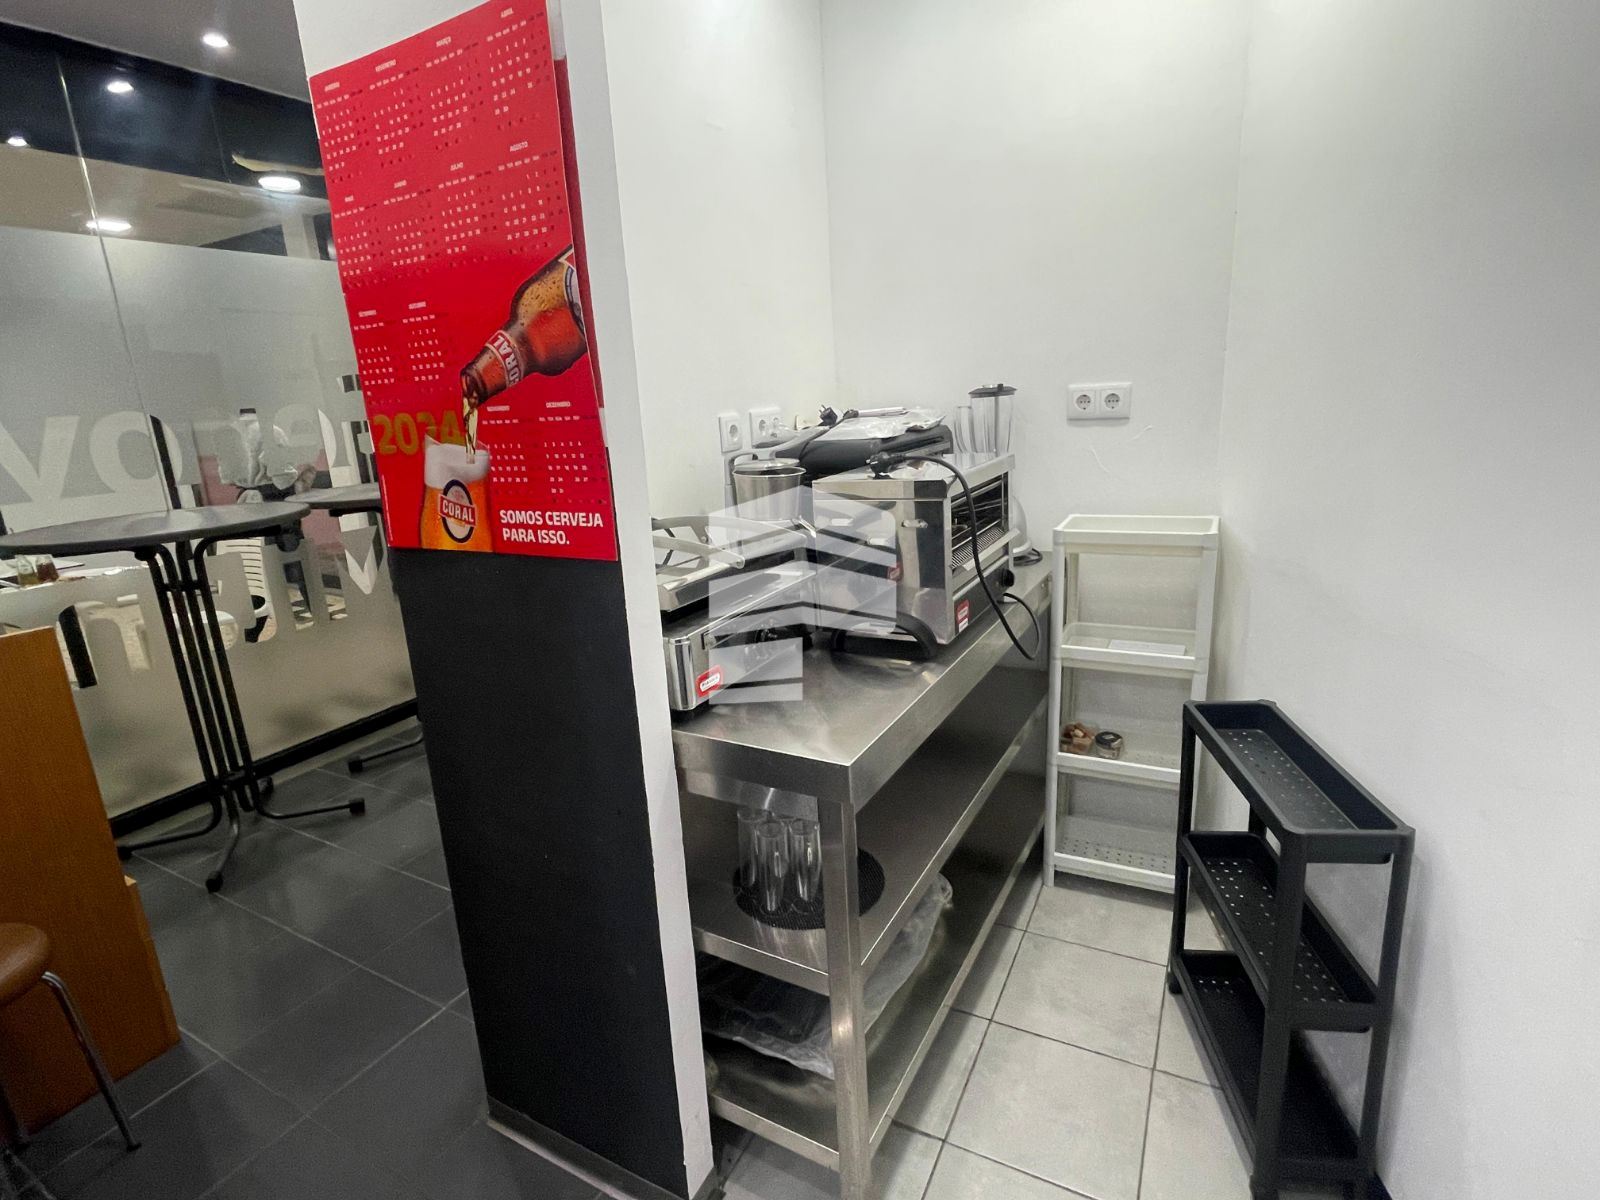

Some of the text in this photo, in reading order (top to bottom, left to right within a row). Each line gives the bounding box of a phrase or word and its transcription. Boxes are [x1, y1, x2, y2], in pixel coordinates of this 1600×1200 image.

[442, 499, 475, 523] CORAL
[499, 509, 604, 528] SOMOS CERVEJA
[502, 527, 570, 545] PARA ISSO.
